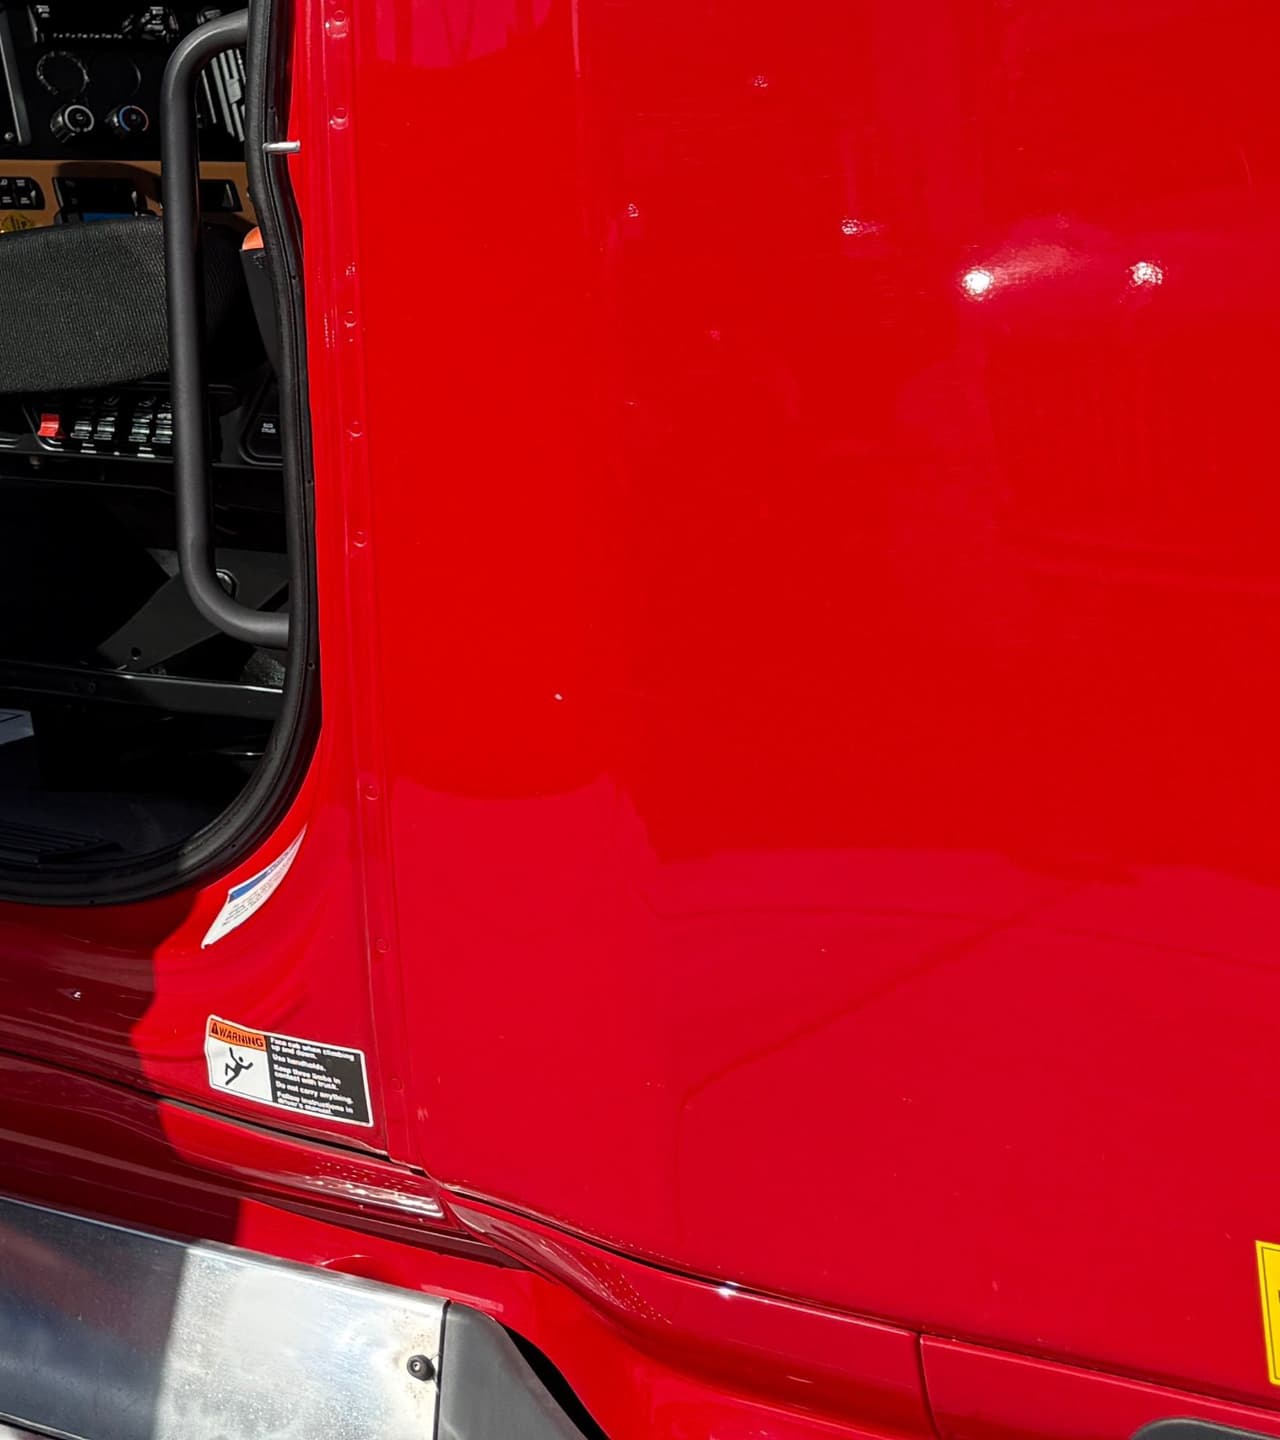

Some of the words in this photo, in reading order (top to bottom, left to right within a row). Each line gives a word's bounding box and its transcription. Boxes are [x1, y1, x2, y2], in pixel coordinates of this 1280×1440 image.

[218, 1027, 264, 1048] WARNING
[272, 1054, 286, 1063] Use
[302, 1043, 321, 1054] when
[323, 1047, 355, 1062] climbing
[273, 1064, 292, 1075] Keep
[292, 1068, 312, 1079] three
[275, 1080, 286, 1090] Do
[287, 1084, 299, 1093] not
[300, 1088, 318, 1099] carry
